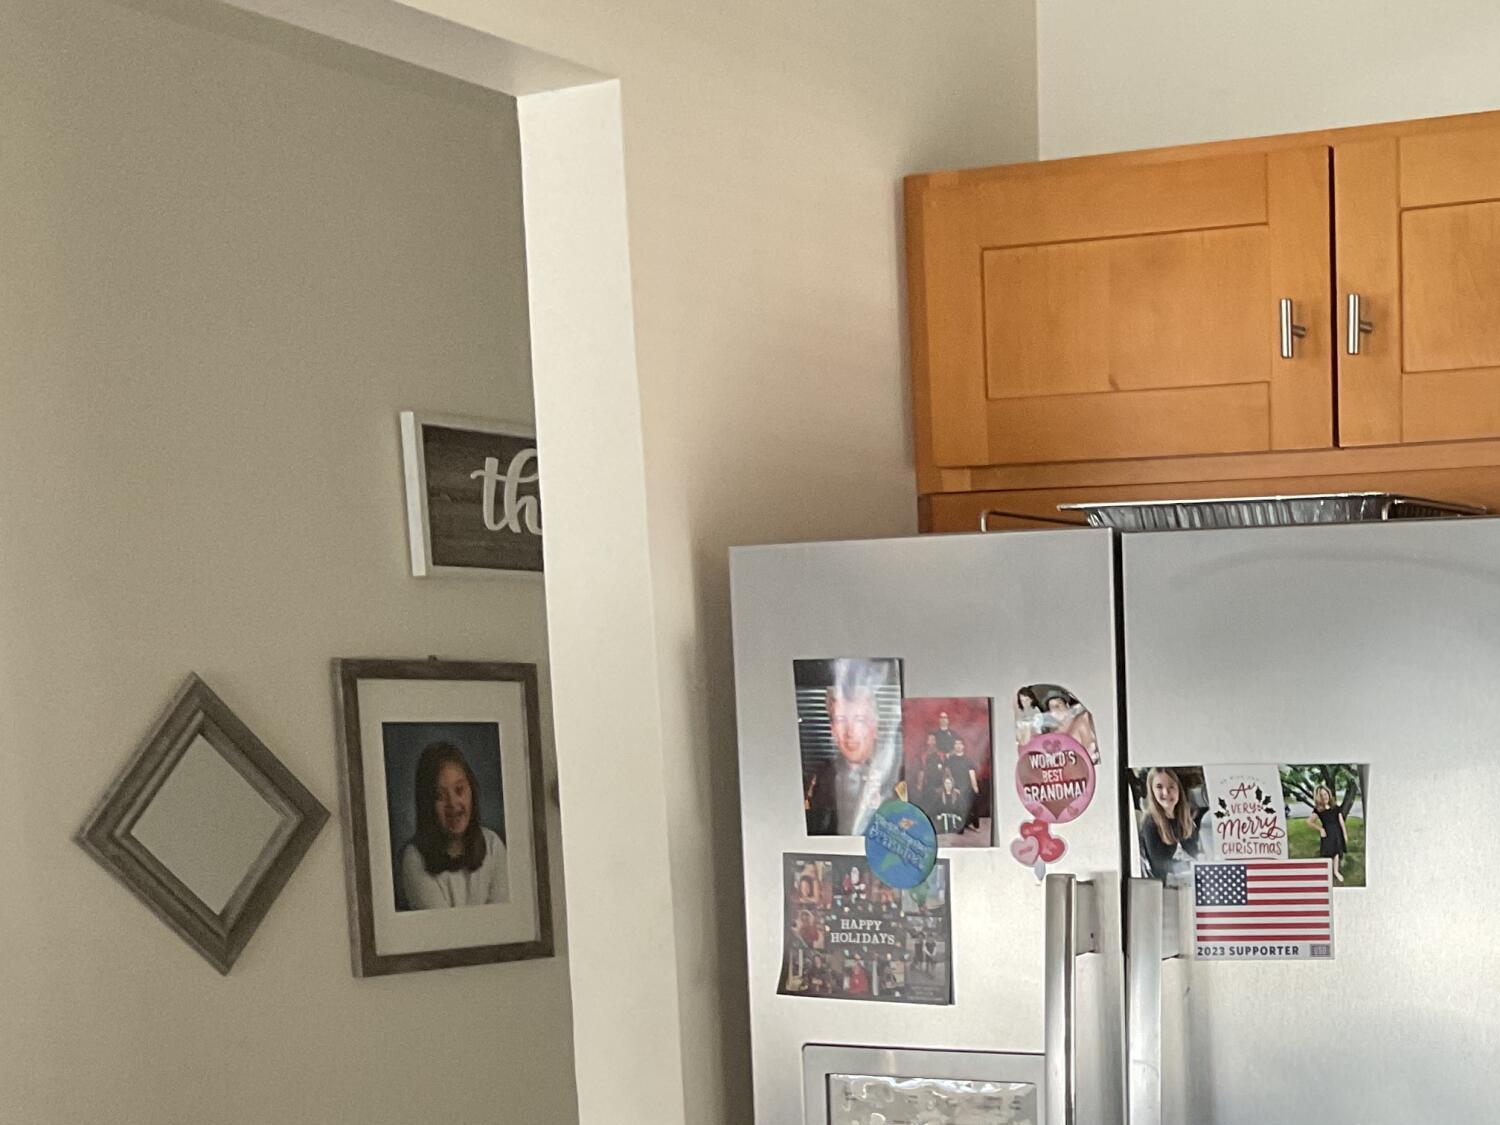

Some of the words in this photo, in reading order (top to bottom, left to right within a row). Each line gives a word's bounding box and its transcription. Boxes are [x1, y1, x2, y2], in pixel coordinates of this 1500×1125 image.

[1042, 768, 1063, 783] BEST
[1231, 802, 1256, 814] VERY
[1217, 816, 1285, 840] Merry
[841, 919, 882, 931] HAPPY
[831, 932, 895, 945] HOLIDAYS
[1197, 946, 1225, 956] 2023
[1229, 945, 1299, 956] SUPPORTER
